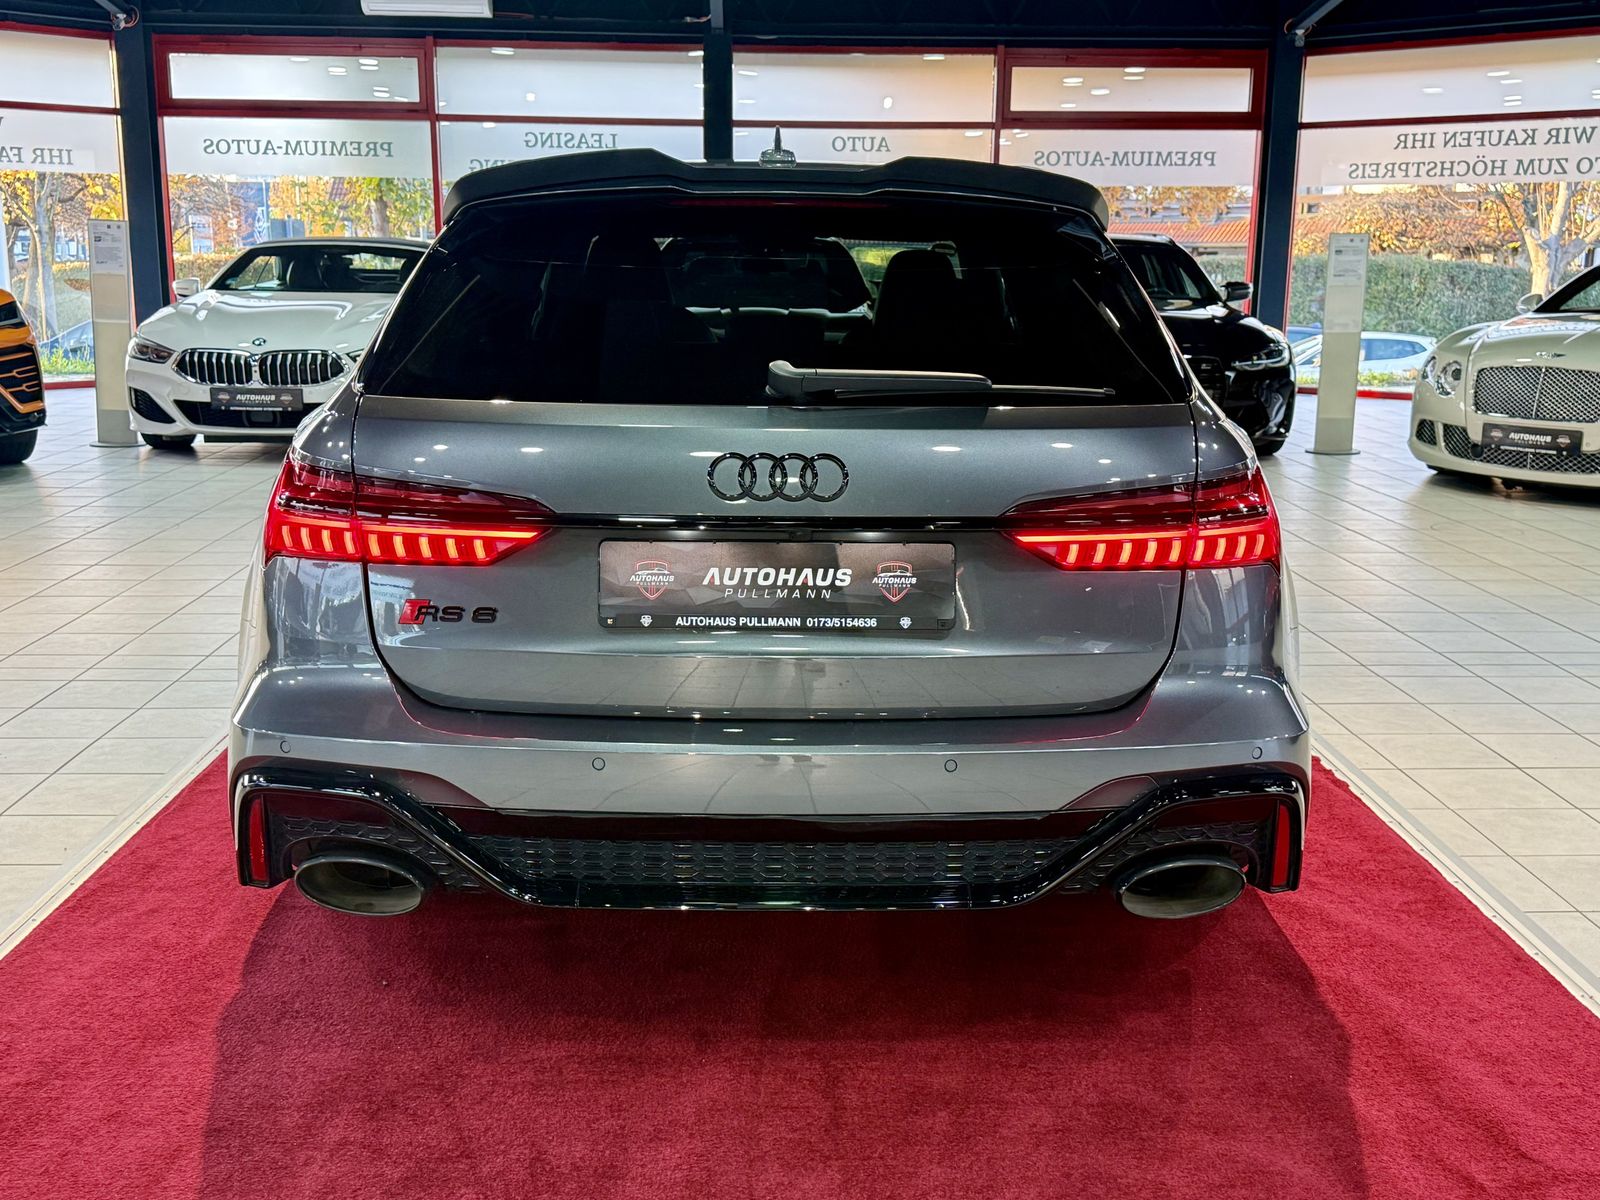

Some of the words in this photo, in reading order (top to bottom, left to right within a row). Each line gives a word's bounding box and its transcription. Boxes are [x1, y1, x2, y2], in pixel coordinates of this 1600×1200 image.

[702, 567, 852, 587] AUTOHAUS
[724, 588, 831, 599] PULLMANN
[408, 603, 465, 623] RS
[471, 606, 498, 624] 6
[675, 616, 736, 626] AUTOHAUS
[739, 617, 801, 627] PULLMANN
[806, 617, 877, 628] 0173/5154636
